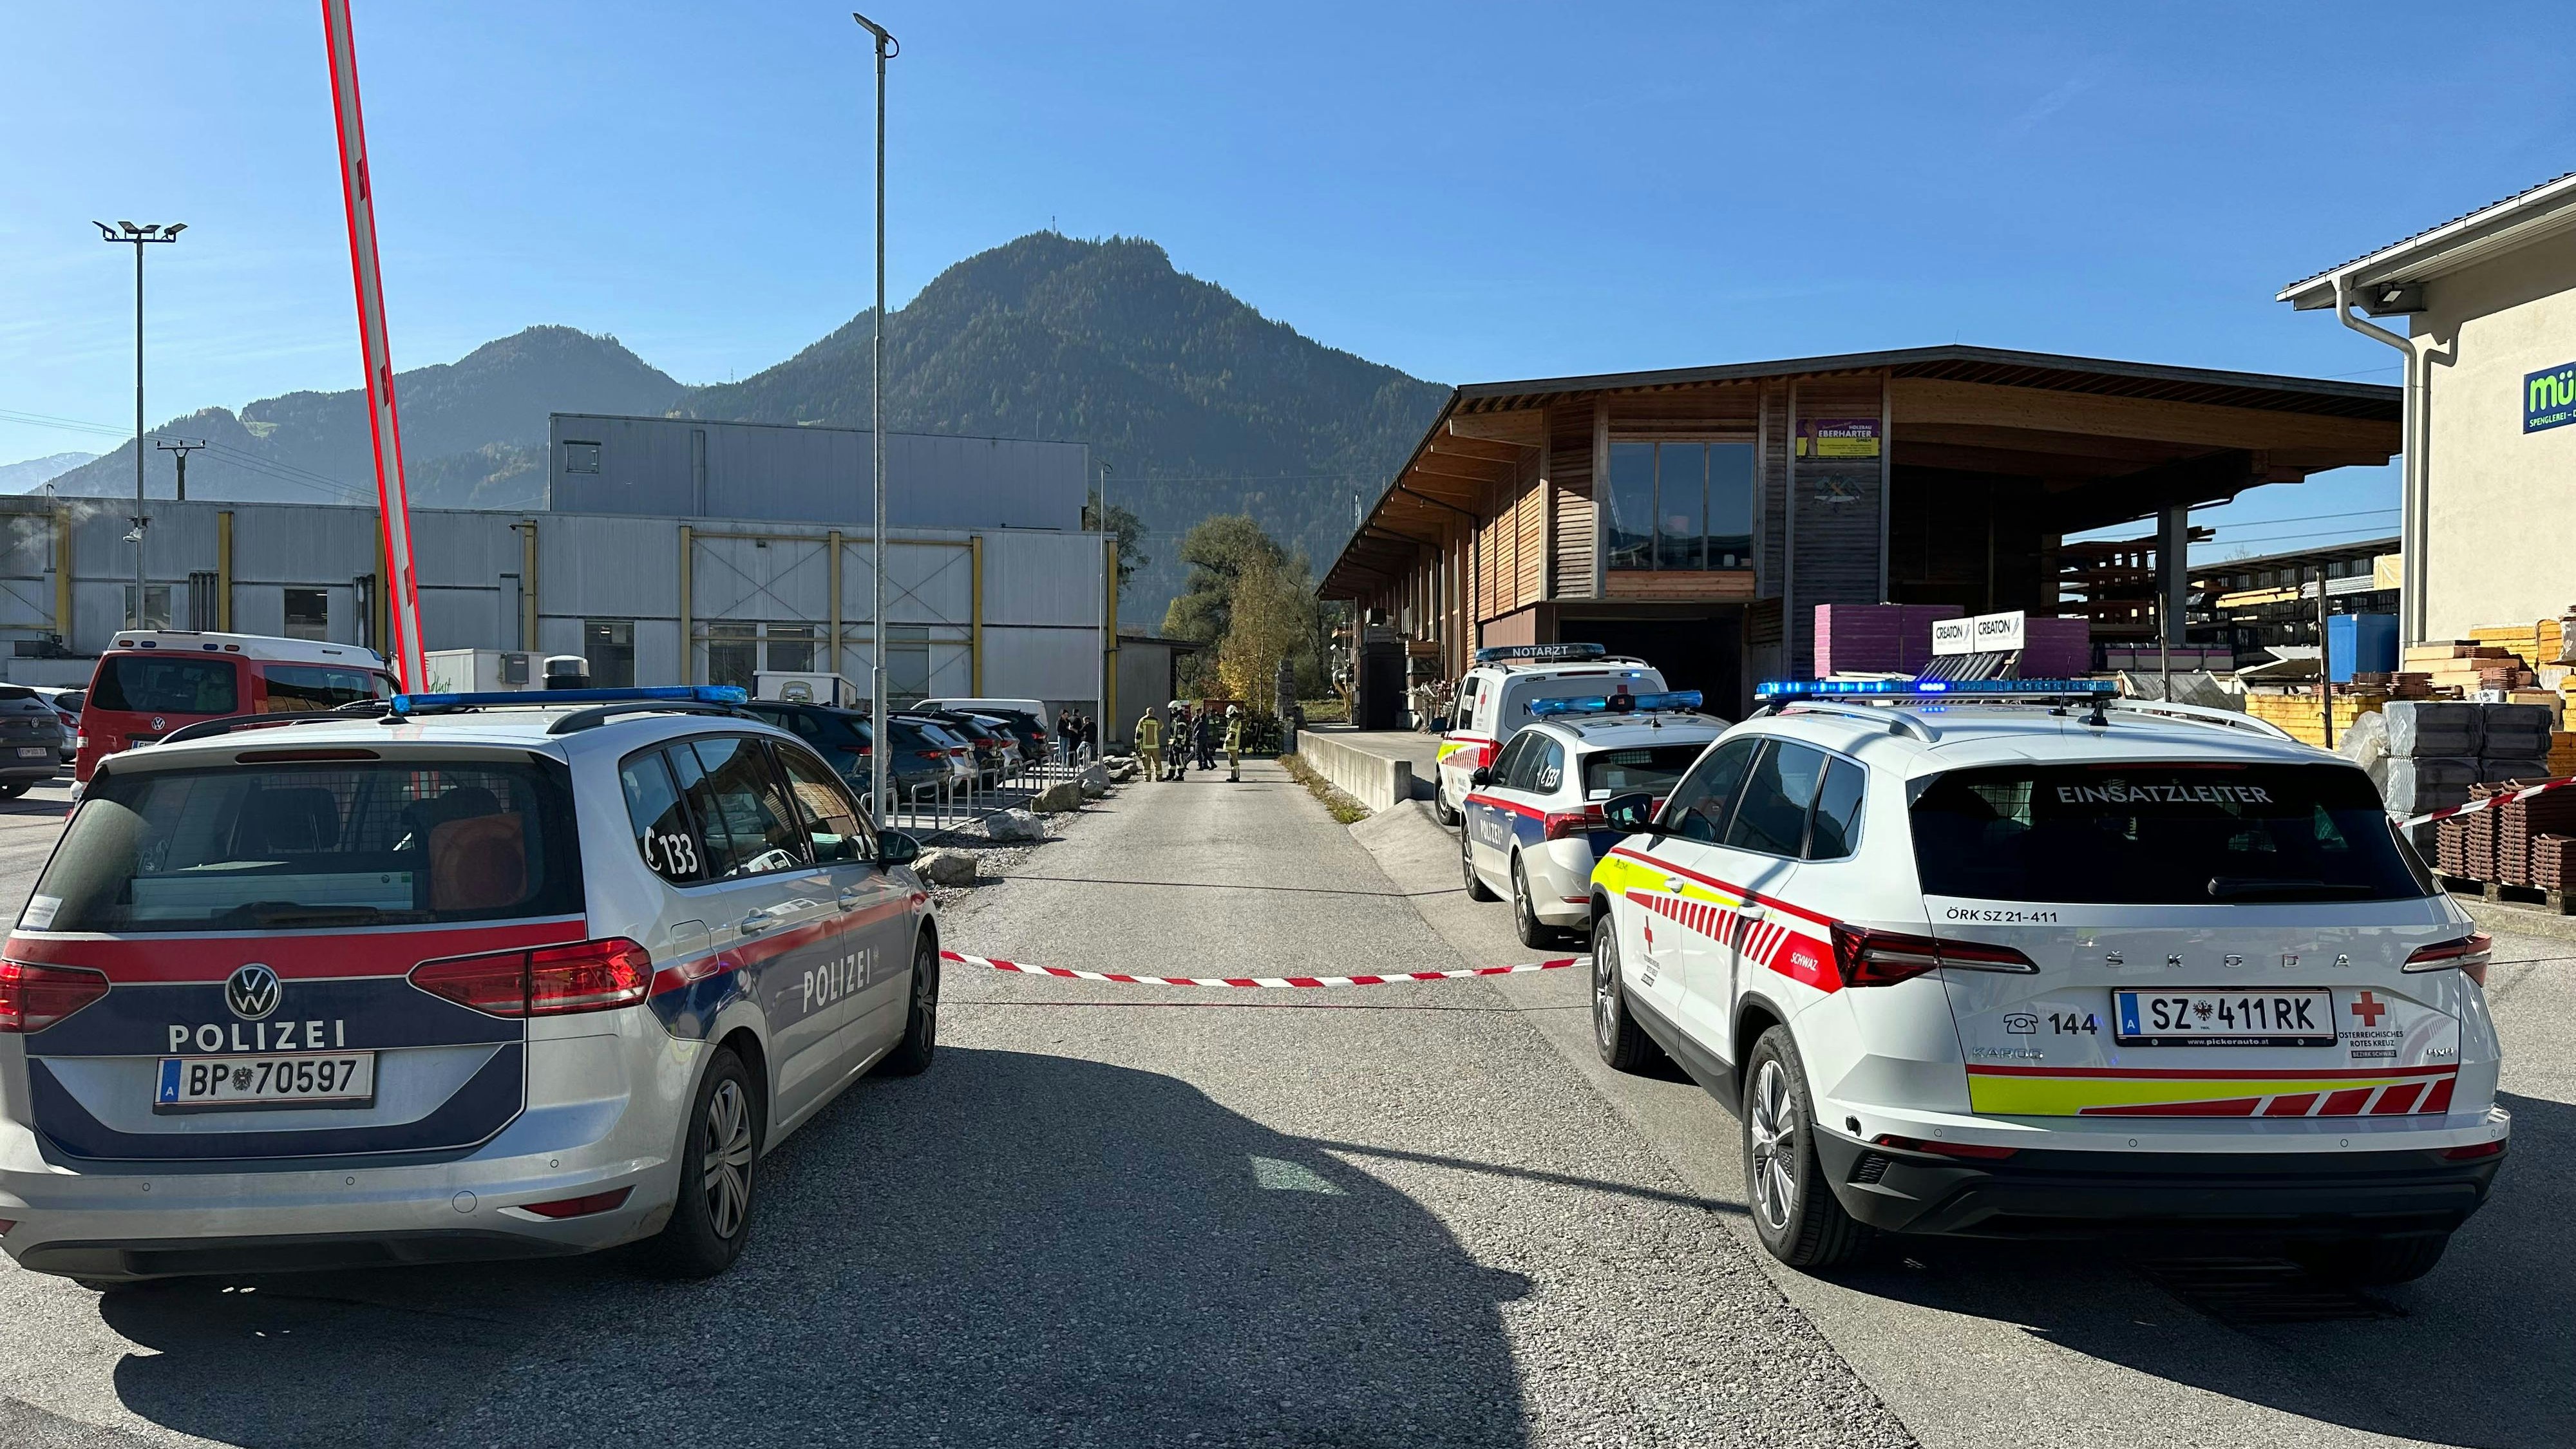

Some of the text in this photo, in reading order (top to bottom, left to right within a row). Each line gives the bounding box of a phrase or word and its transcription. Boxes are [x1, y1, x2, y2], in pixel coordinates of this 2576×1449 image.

[2530, 370, 2576, 413] mü
[2530, 412, 2566, 427] SPENGLEREI
[1936, 622, 1962, 639] CREATON
[1978, 619, 2010, 635] CREATON
[1512, 646, 1568, 657] NOTARZT
[428, 671, 452, 693] dlust
[1545, 768, 1560, 787] 133
[2057, 786, 2274, 802] EINSATZLEITER
[1480, 820, 1501, 845] POLIZEI
[658, 833, 697, 875] 133
[1946, 906, 2058, 922] ÖRK SZ 21-411
[1790, 952, 1818, 971] SCHWAZ
[2106, 951, 2351, 967] ŠKODA
[803, 948, 870, 1013] POLIZEI
[2126, 1019, 2136, 1029] A
[2151, 998, 2192, 1030] SZ
[2048, 1013, 2098, 1035] 144
[169, 1019, 345, 1052] POLIZEI
[2338, 1030, 2403, 1039] ÖSTERREICHISCHES
[1973, 1046, 2044, 1059] KAROQ
[165, 1060, 357, 1096] A BP 70597
